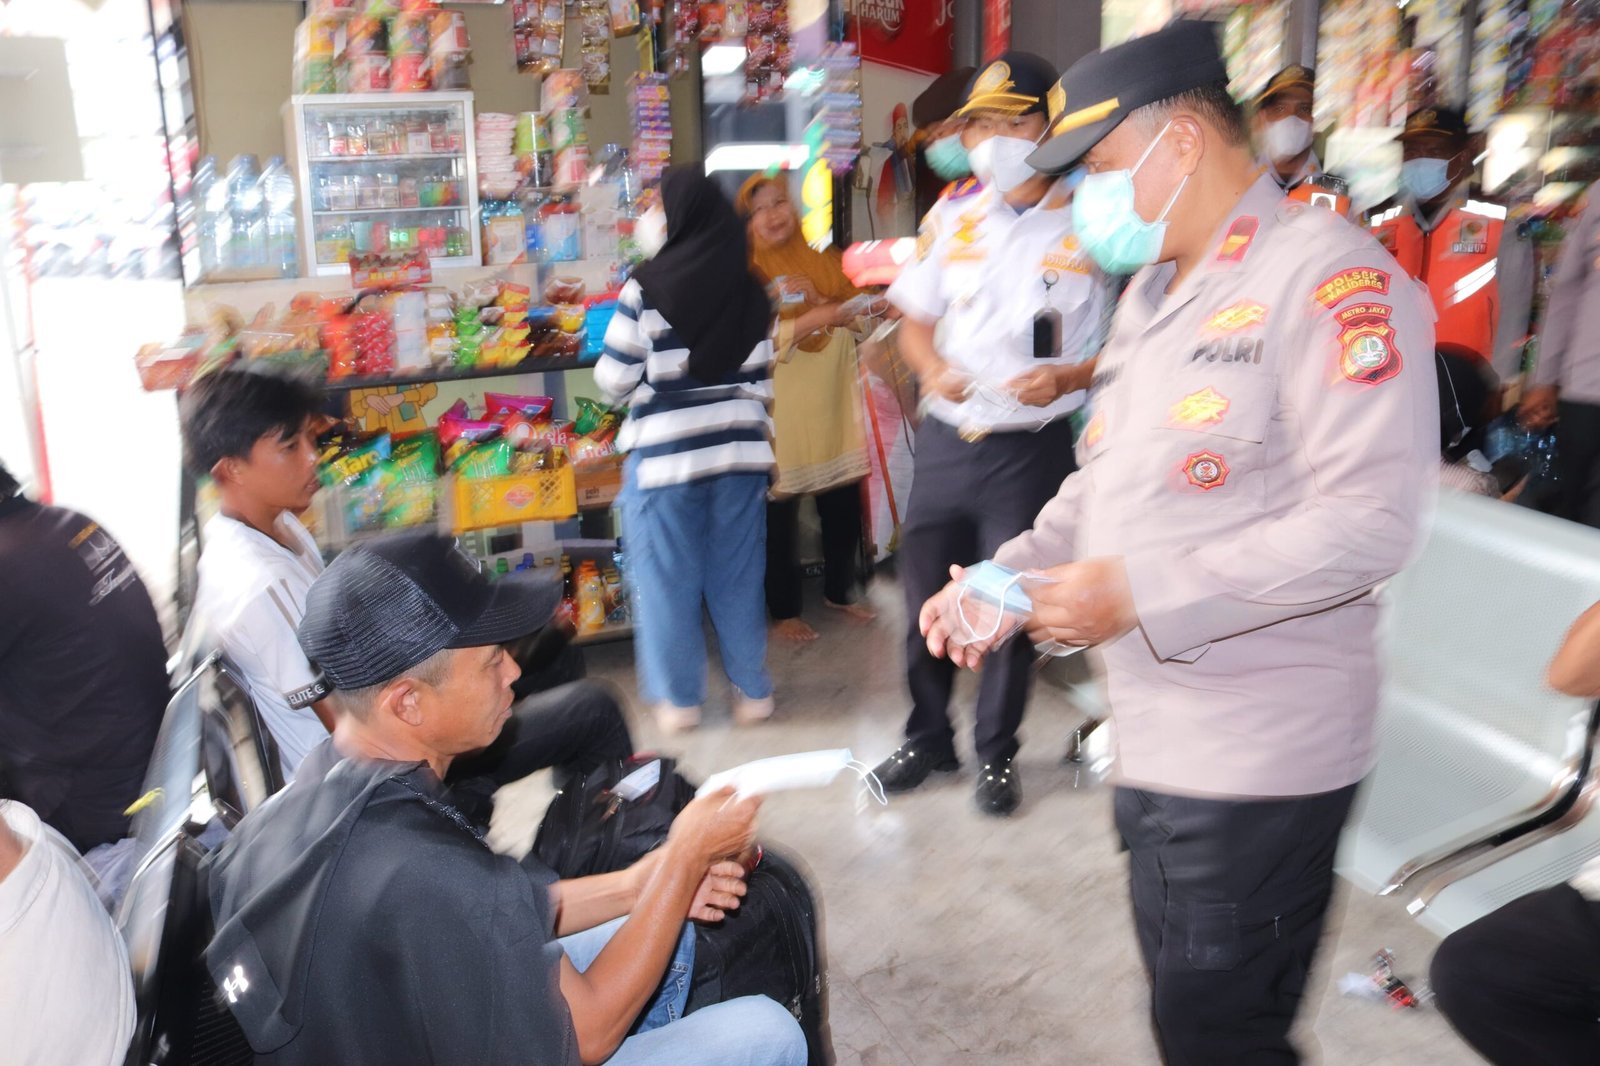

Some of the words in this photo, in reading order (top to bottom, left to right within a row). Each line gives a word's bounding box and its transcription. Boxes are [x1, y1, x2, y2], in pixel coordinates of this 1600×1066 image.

[861, 4, 900, 23] HARUM
[1325, 271, 1379, 292] POLSEK
[1327, 280, 1383, 301] KALIDERES
[1341, 306, 1366, 320] METRO
[1368, 307, 1386, 315] JAYA
[1192, 337, 1264, 365] POLRI
[289, 688, 314, 704] ELITE
